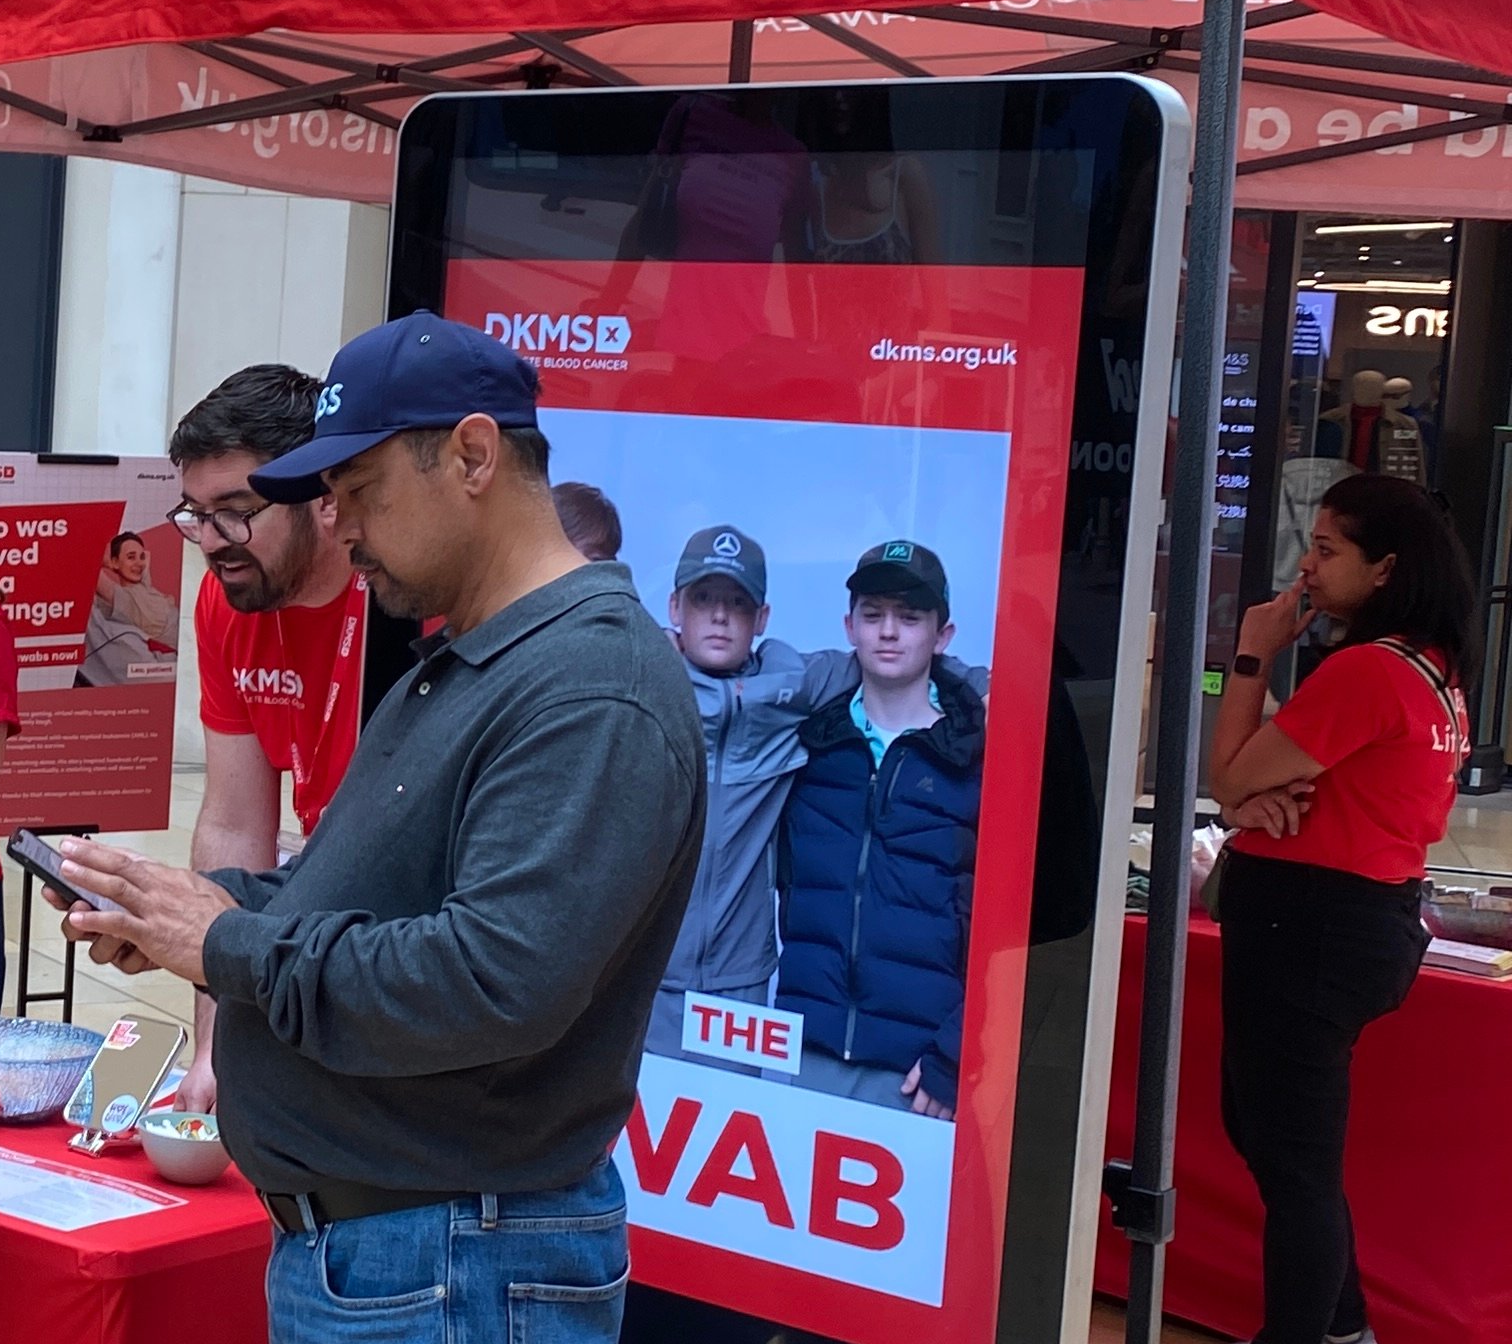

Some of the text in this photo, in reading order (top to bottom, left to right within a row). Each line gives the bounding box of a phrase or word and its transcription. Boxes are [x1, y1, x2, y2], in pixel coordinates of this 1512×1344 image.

[484, 312, 1018, 370] DKMS dkms.org.uk
[544, 357, 580, 370] BLOOD
[583, 359, 628, 371] CANCER
[16, 517, 68, 538] was
[0, 600, 75, 626] anger
[17, 649, 79, 663] wabs now!
[233, 667, 299, 696] KMS
[691, 1003, 791, 1060] THE
